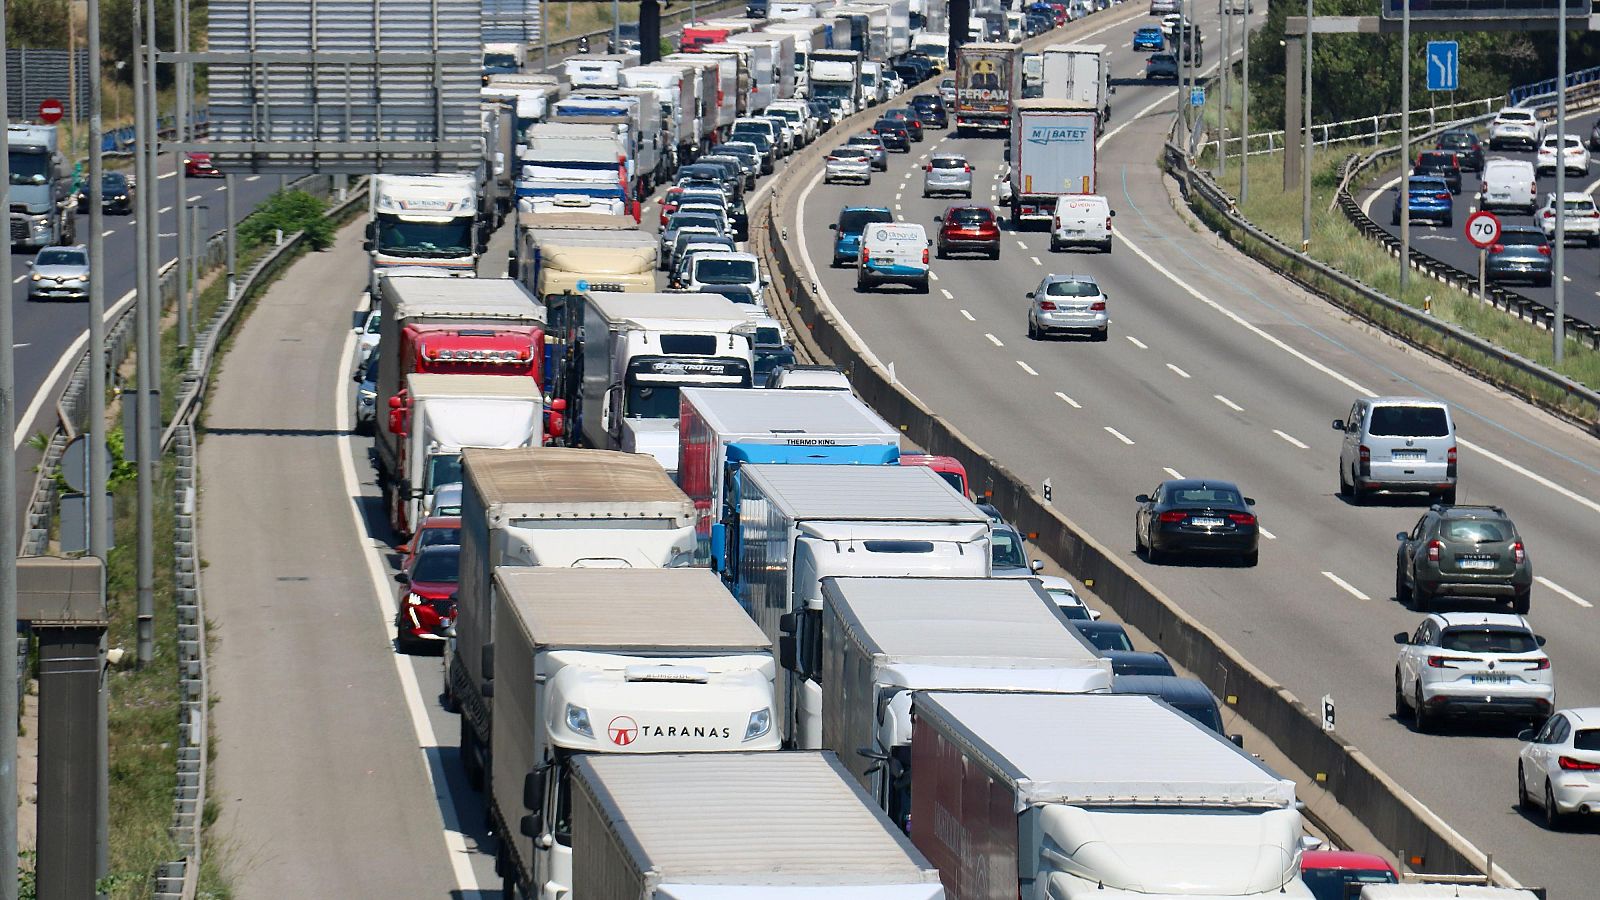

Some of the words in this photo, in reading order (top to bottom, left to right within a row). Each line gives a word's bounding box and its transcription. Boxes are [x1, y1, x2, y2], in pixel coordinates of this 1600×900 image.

[958, 88, 1009, 100] FERCAM
[1052, 130, 1087, 138] BATET
[1474, 223, 1493, 235] 70
[642, 726, 730, 739] TARANAS
